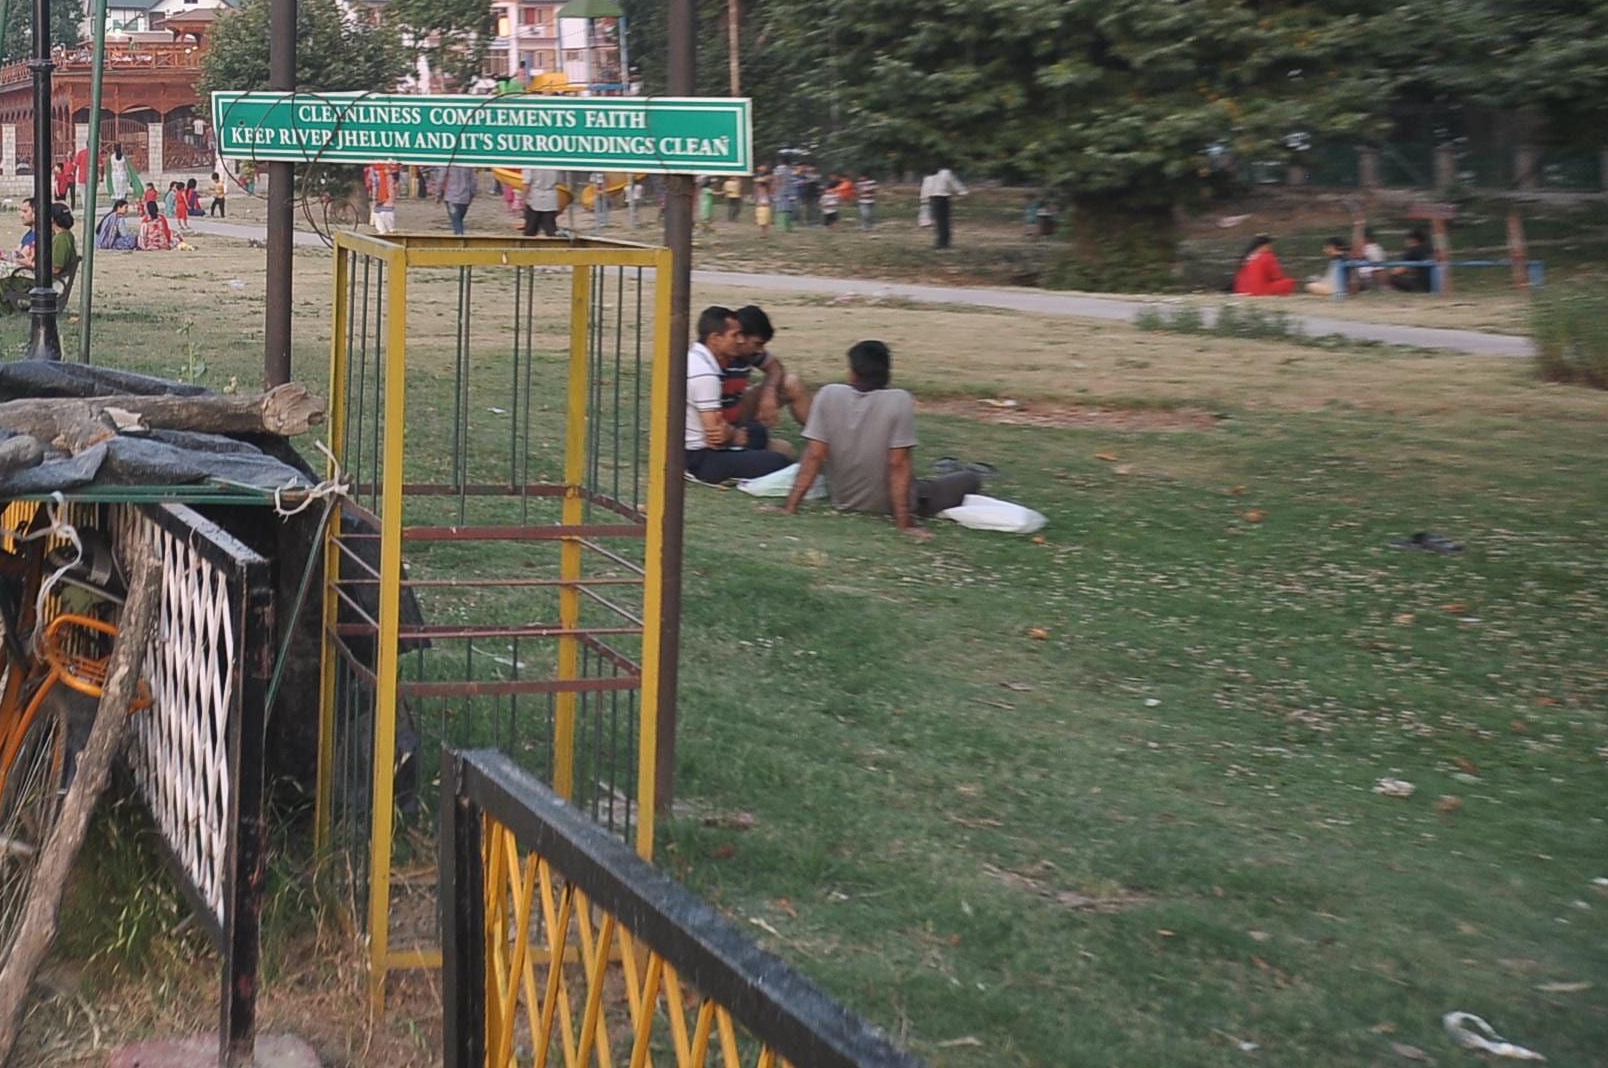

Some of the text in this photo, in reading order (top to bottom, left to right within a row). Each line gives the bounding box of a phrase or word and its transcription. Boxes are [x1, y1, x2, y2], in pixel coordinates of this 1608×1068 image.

[298, 105, 647, 129] CLEANLINESS COMPLEMENTS FAITH
[231, 127, 730, 157] KEEP RIVER JHELUM AND IT'S SURROUNDINGS CLEAN
